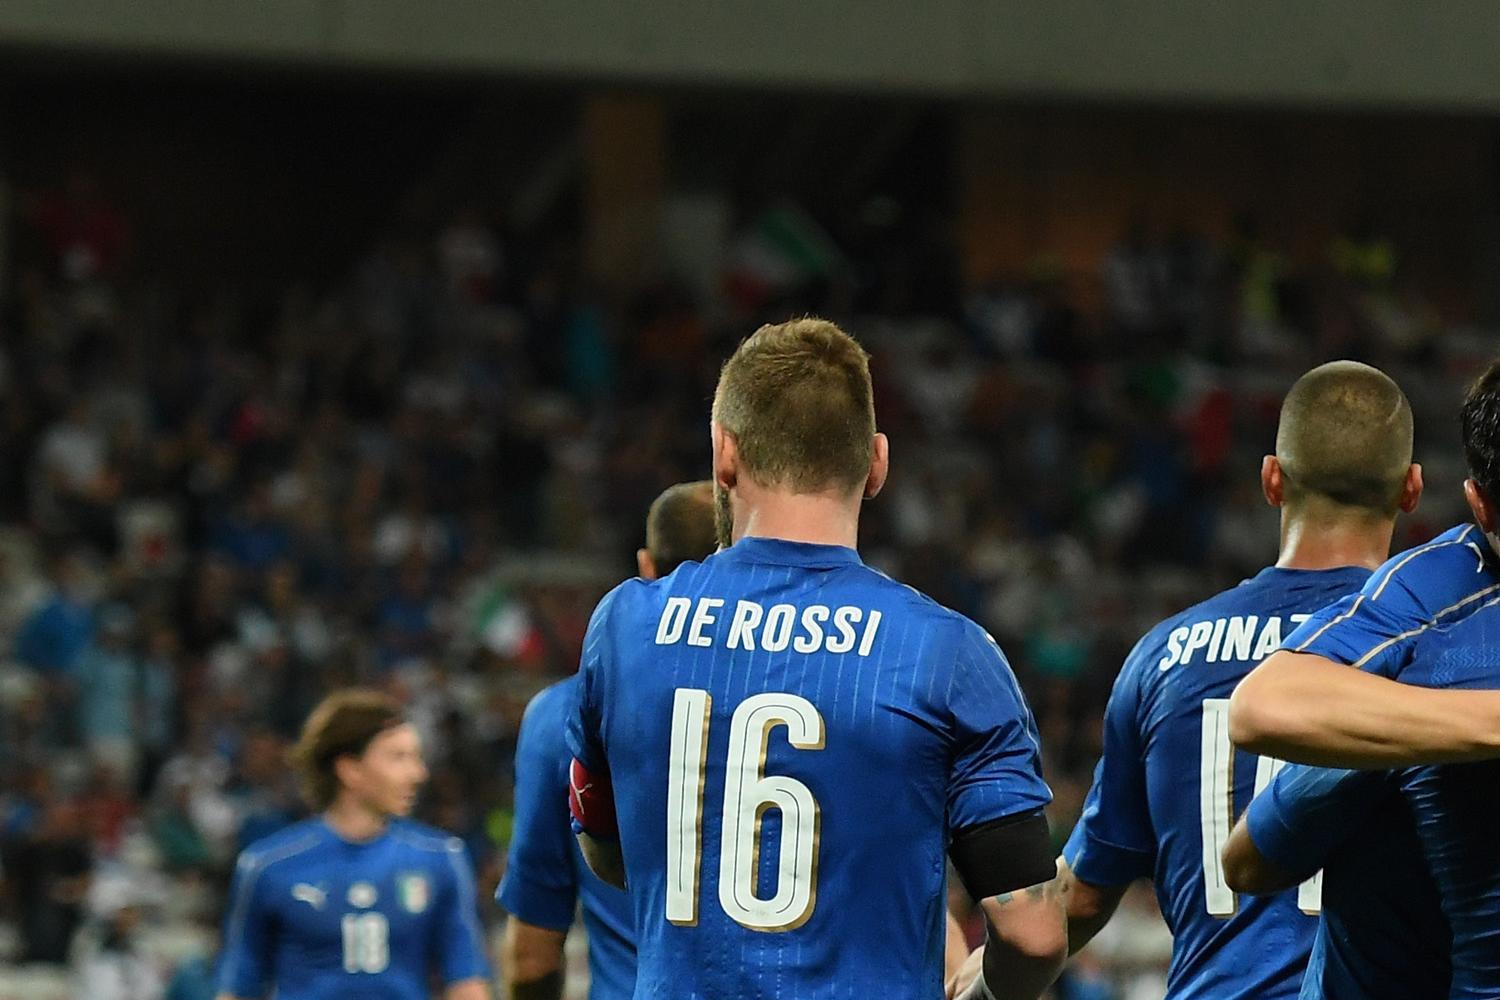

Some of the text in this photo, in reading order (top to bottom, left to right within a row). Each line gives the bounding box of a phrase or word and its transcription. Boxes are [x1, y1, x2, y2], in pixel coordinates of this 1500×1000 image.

[655, 597, 882, 657] DE ROSSI
[666, 687, 826, 933] 16
[1200, 698, 1324, 918] 1
